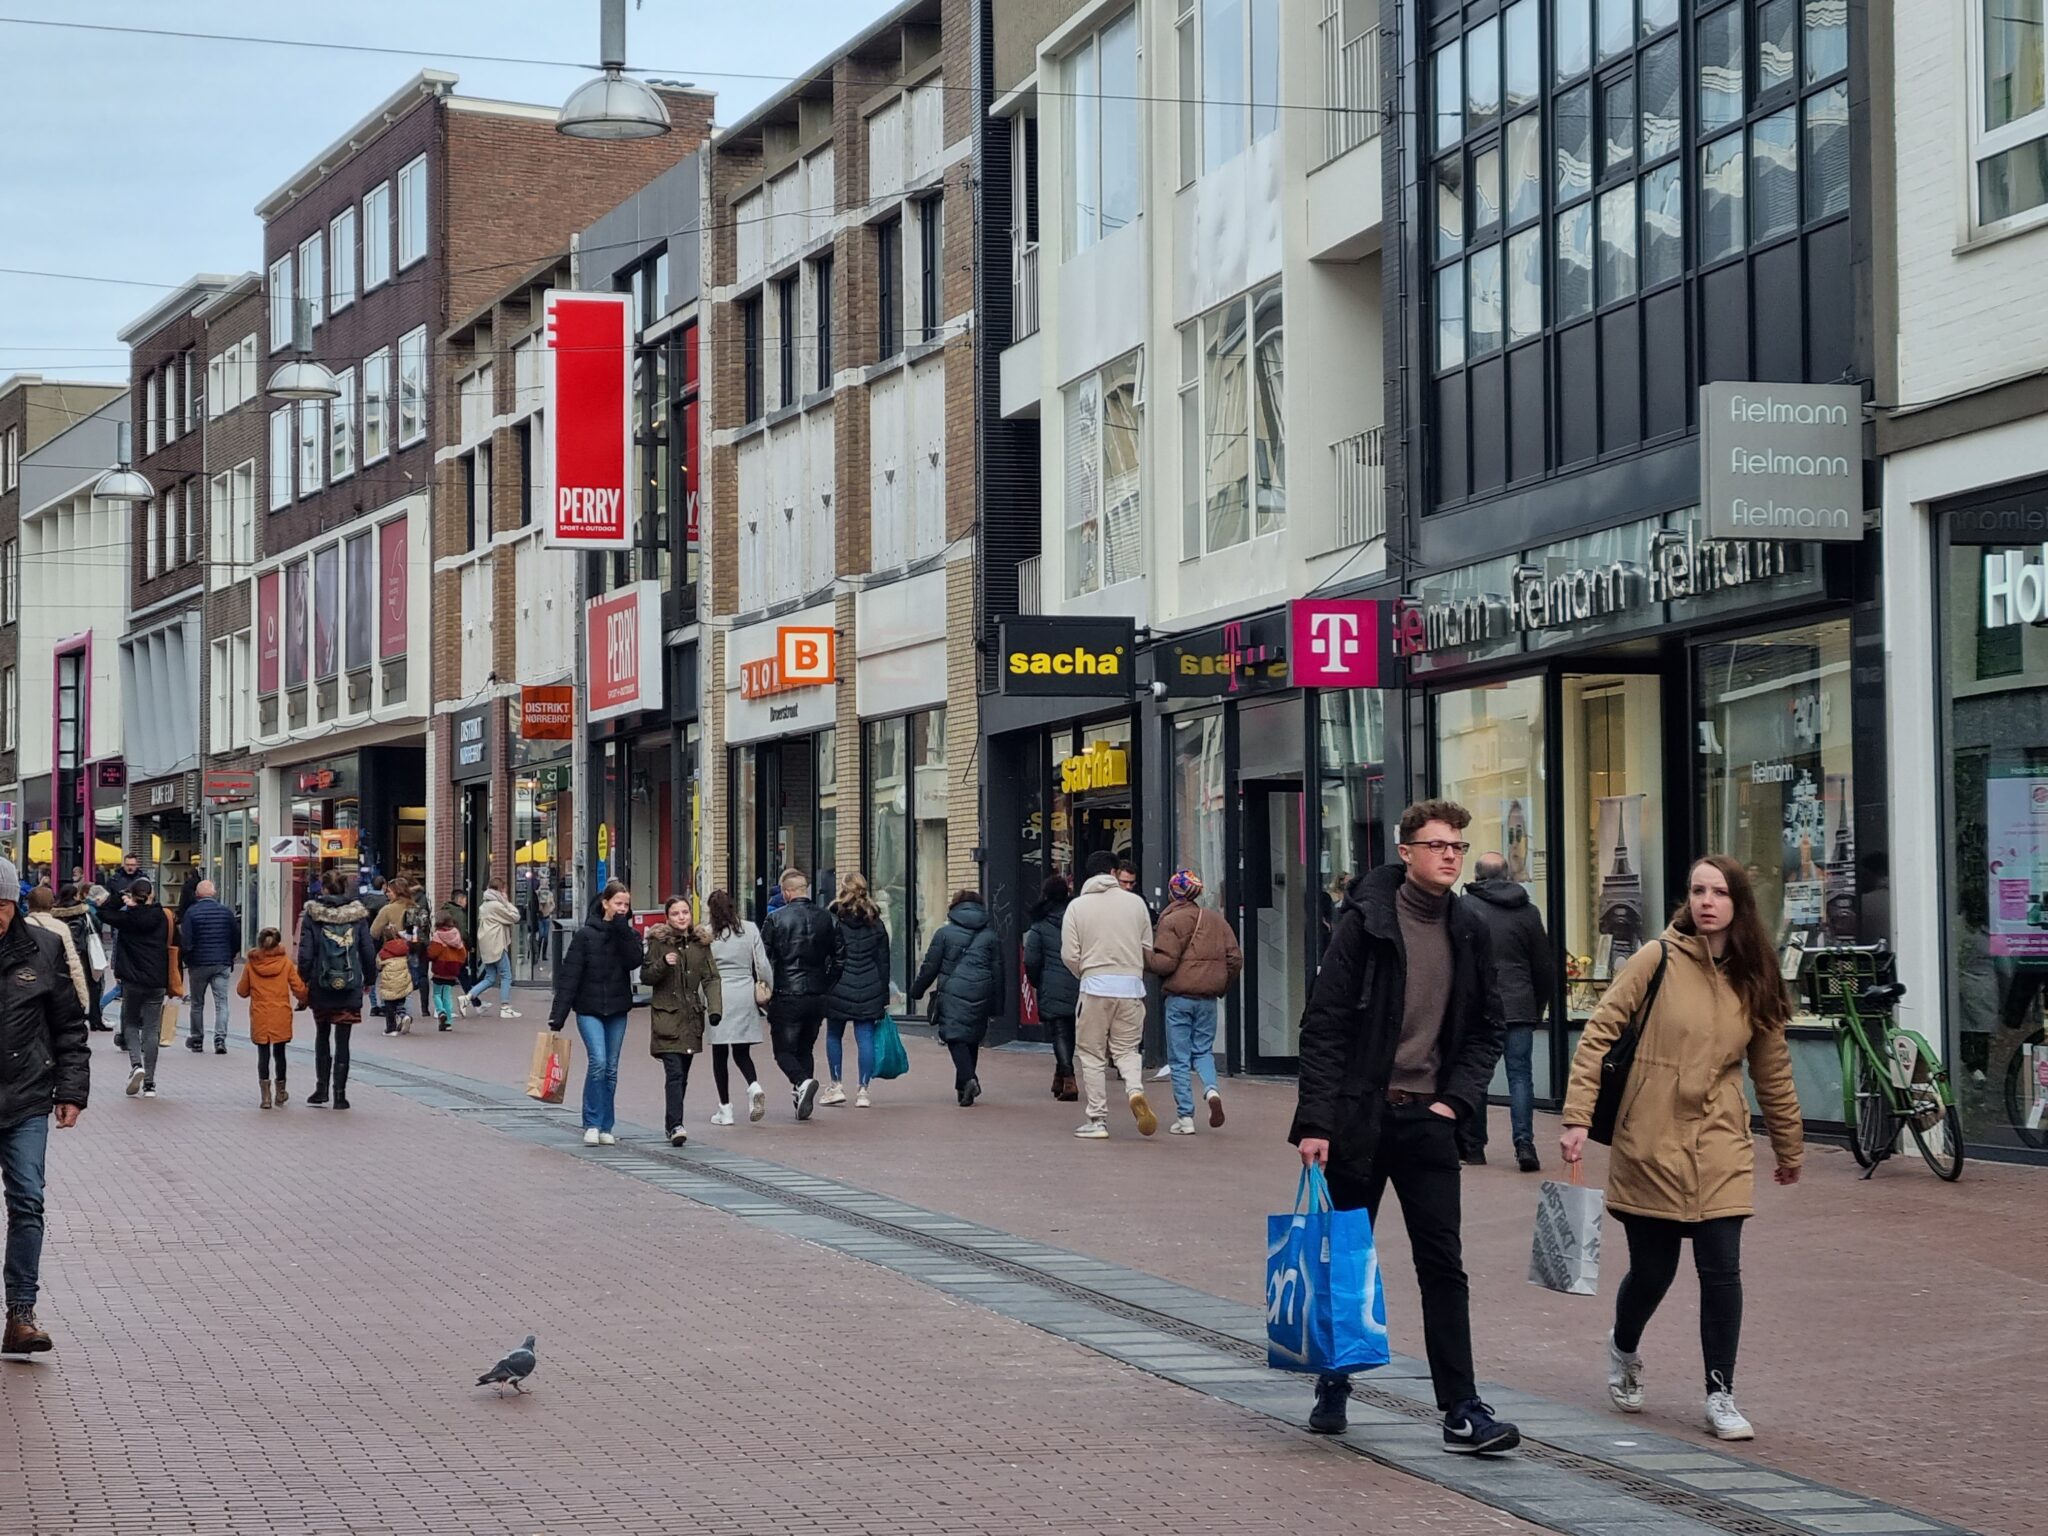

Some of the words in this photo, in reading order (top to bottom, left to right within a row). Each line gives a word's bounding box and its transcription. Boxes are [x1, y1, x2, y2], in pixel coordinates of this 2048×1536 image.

[559, 487, 621, 524] PERRY
[608, 605, 636, 684] PERRY
[795, 640, 819, 671] B
[1311, 613, 1359, 673] T
[525, 702, 569, 713] DISTRIKT
